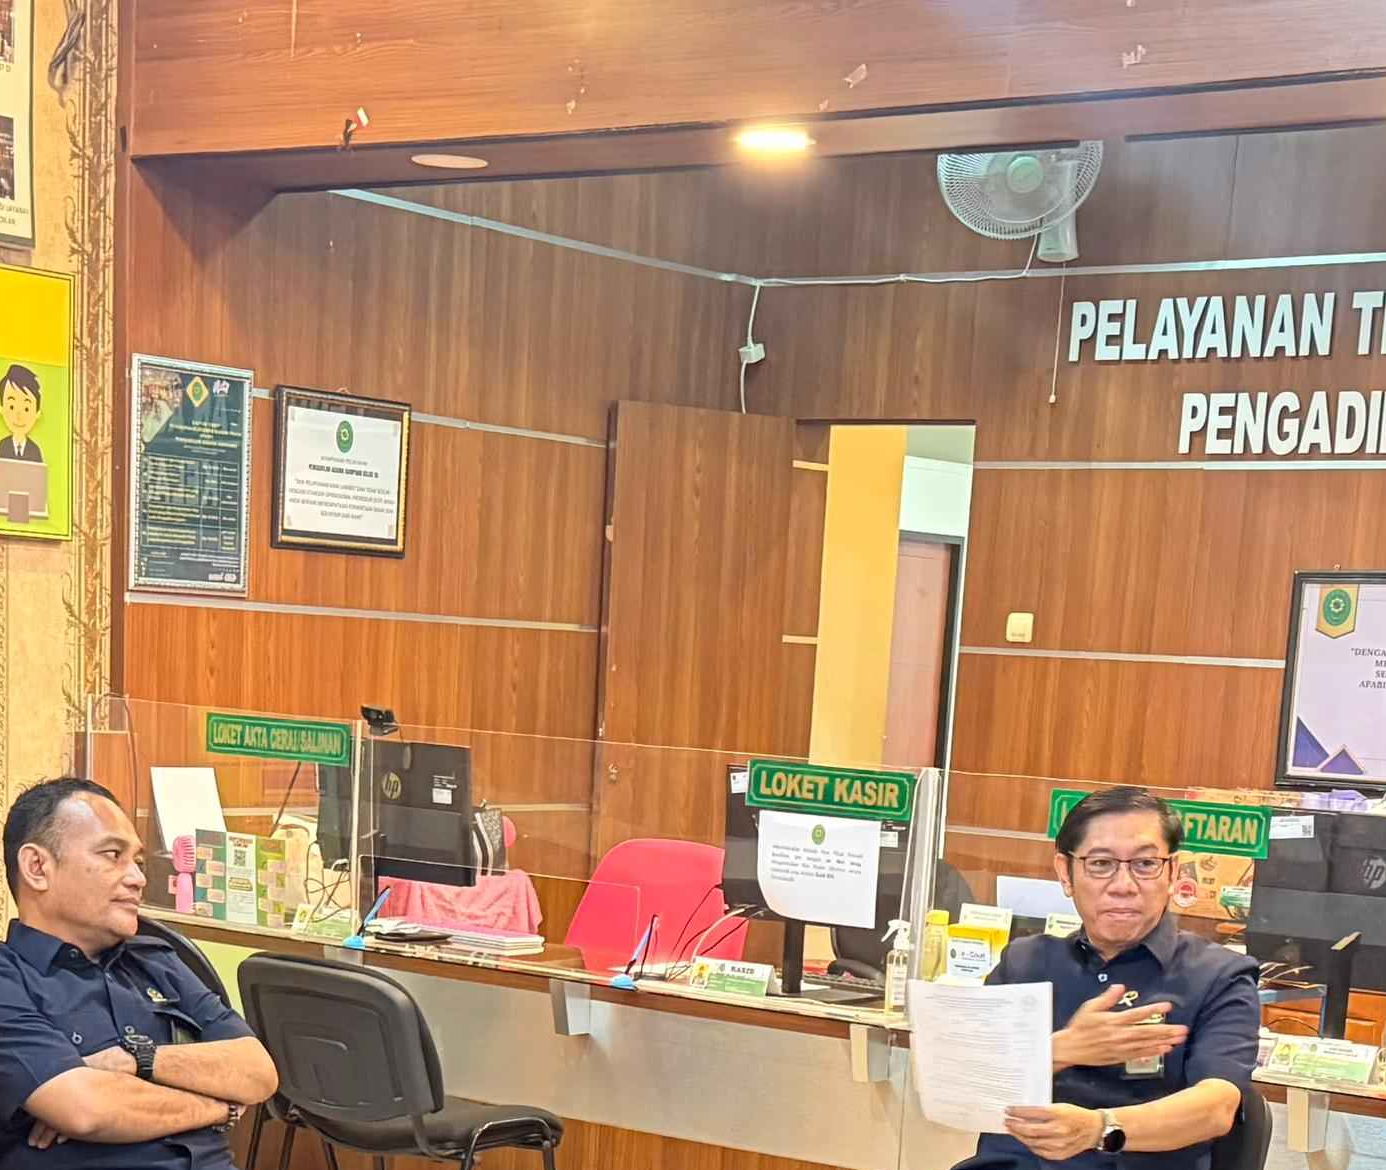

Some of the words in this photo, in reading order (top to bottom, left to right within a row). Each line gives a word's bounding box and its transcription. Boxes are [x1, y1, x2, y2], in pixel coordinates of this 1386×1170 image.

[1068, 292, 1336, 363] PELAYANAN
[213, 723, 242, 745] LOKET
[244, 726, 268, 750] AKTA
[758, 772, 831, 801] LOKET
[833, 778, 899, 808] KASIR
